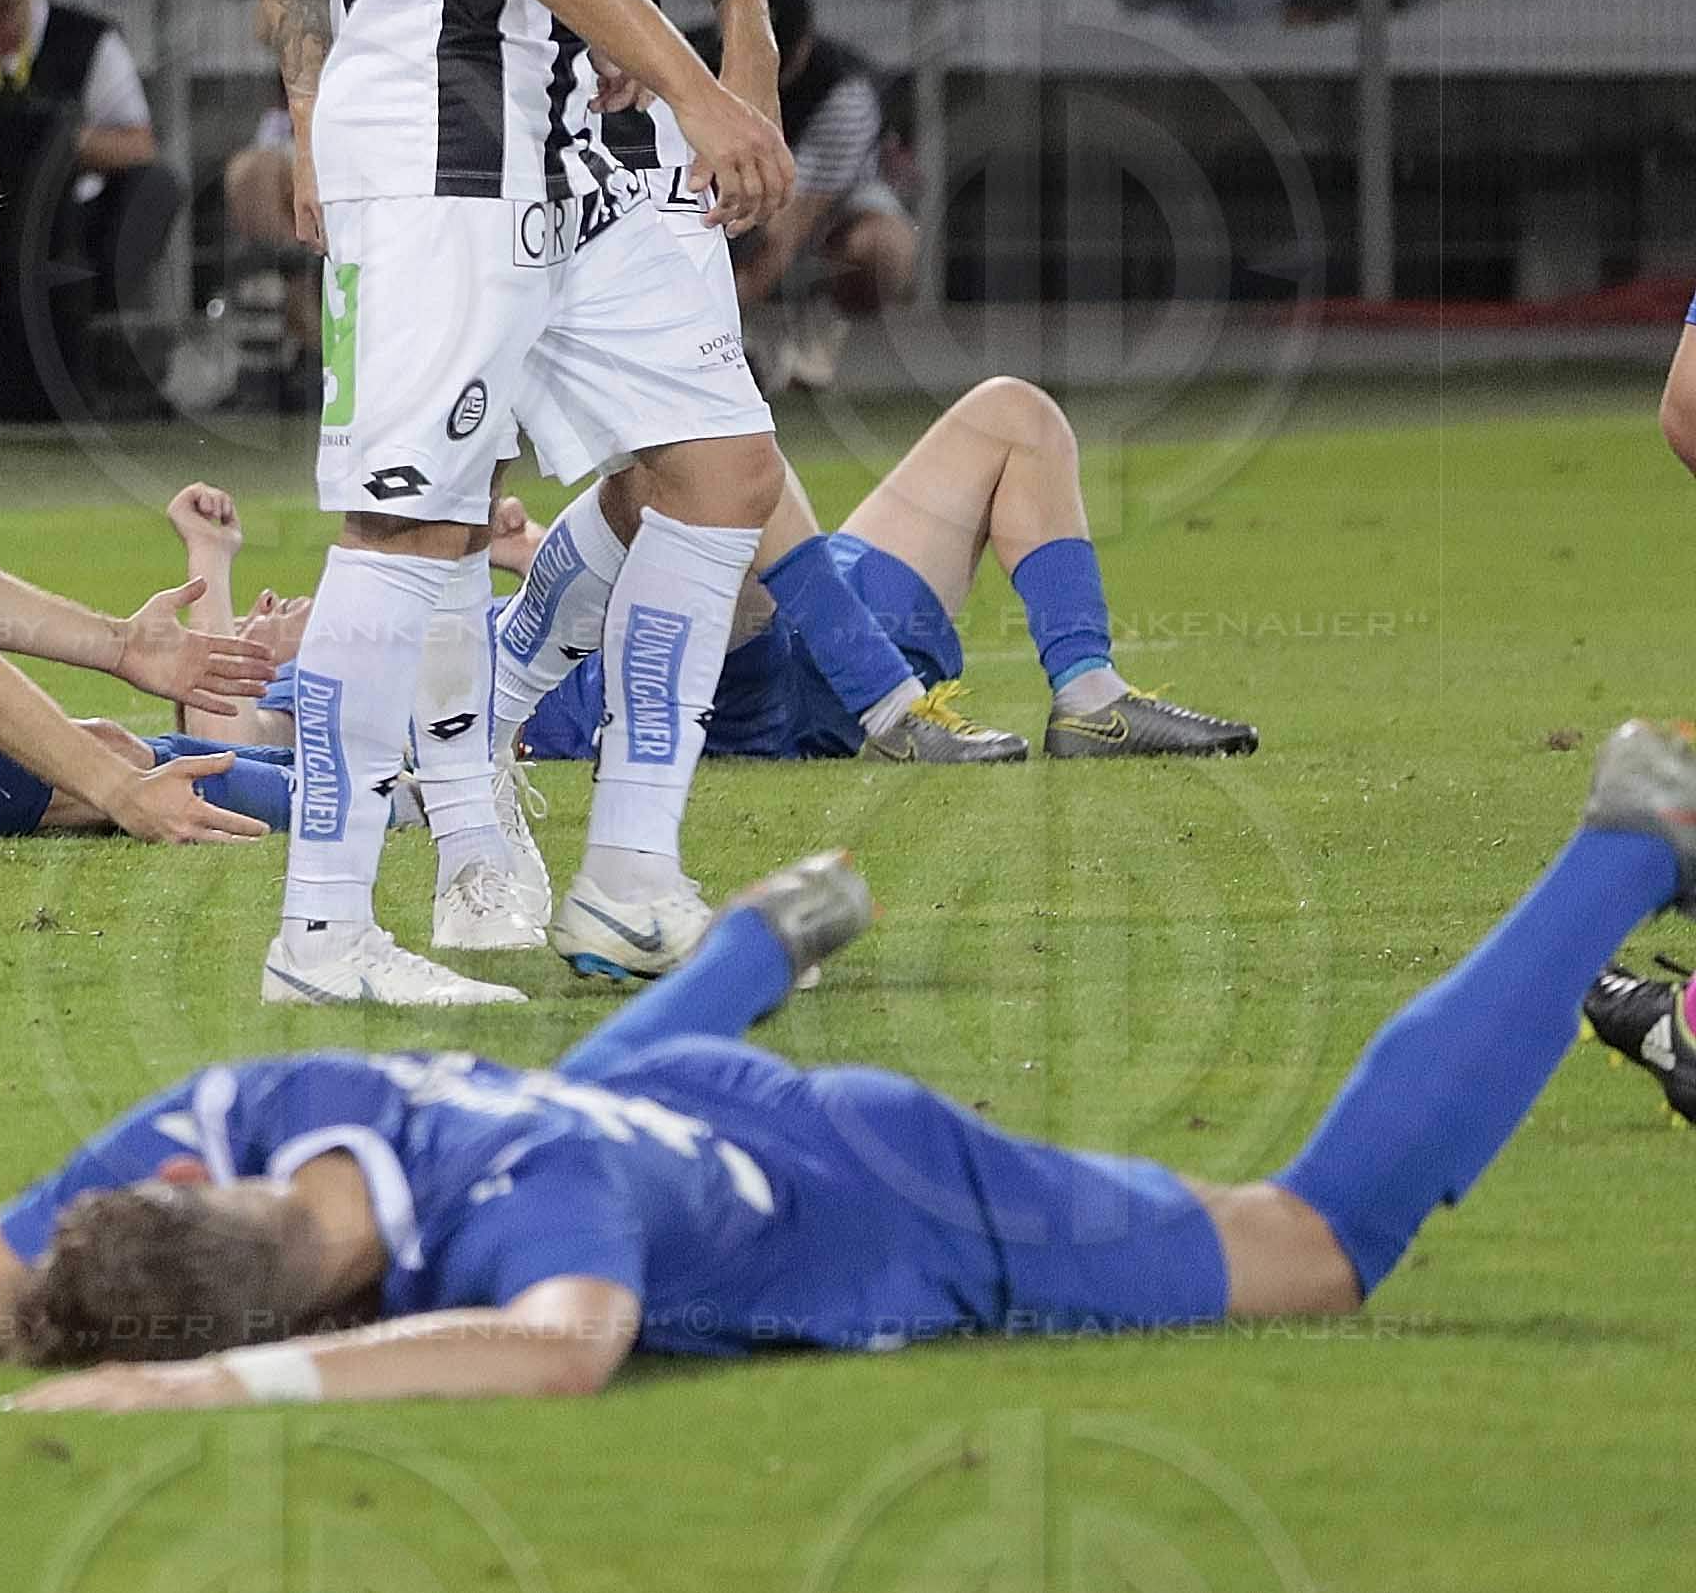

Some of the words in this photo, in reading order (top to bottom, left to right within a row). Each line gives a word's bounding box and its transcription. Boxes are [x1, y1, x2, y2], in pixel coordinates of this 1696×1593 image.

[505, 531, 576, 656] PUNTIGAMER
[298, 678, 339, 838] PUNTIGAMER
[629, 611, 683, 759] PUNTIGAMER
